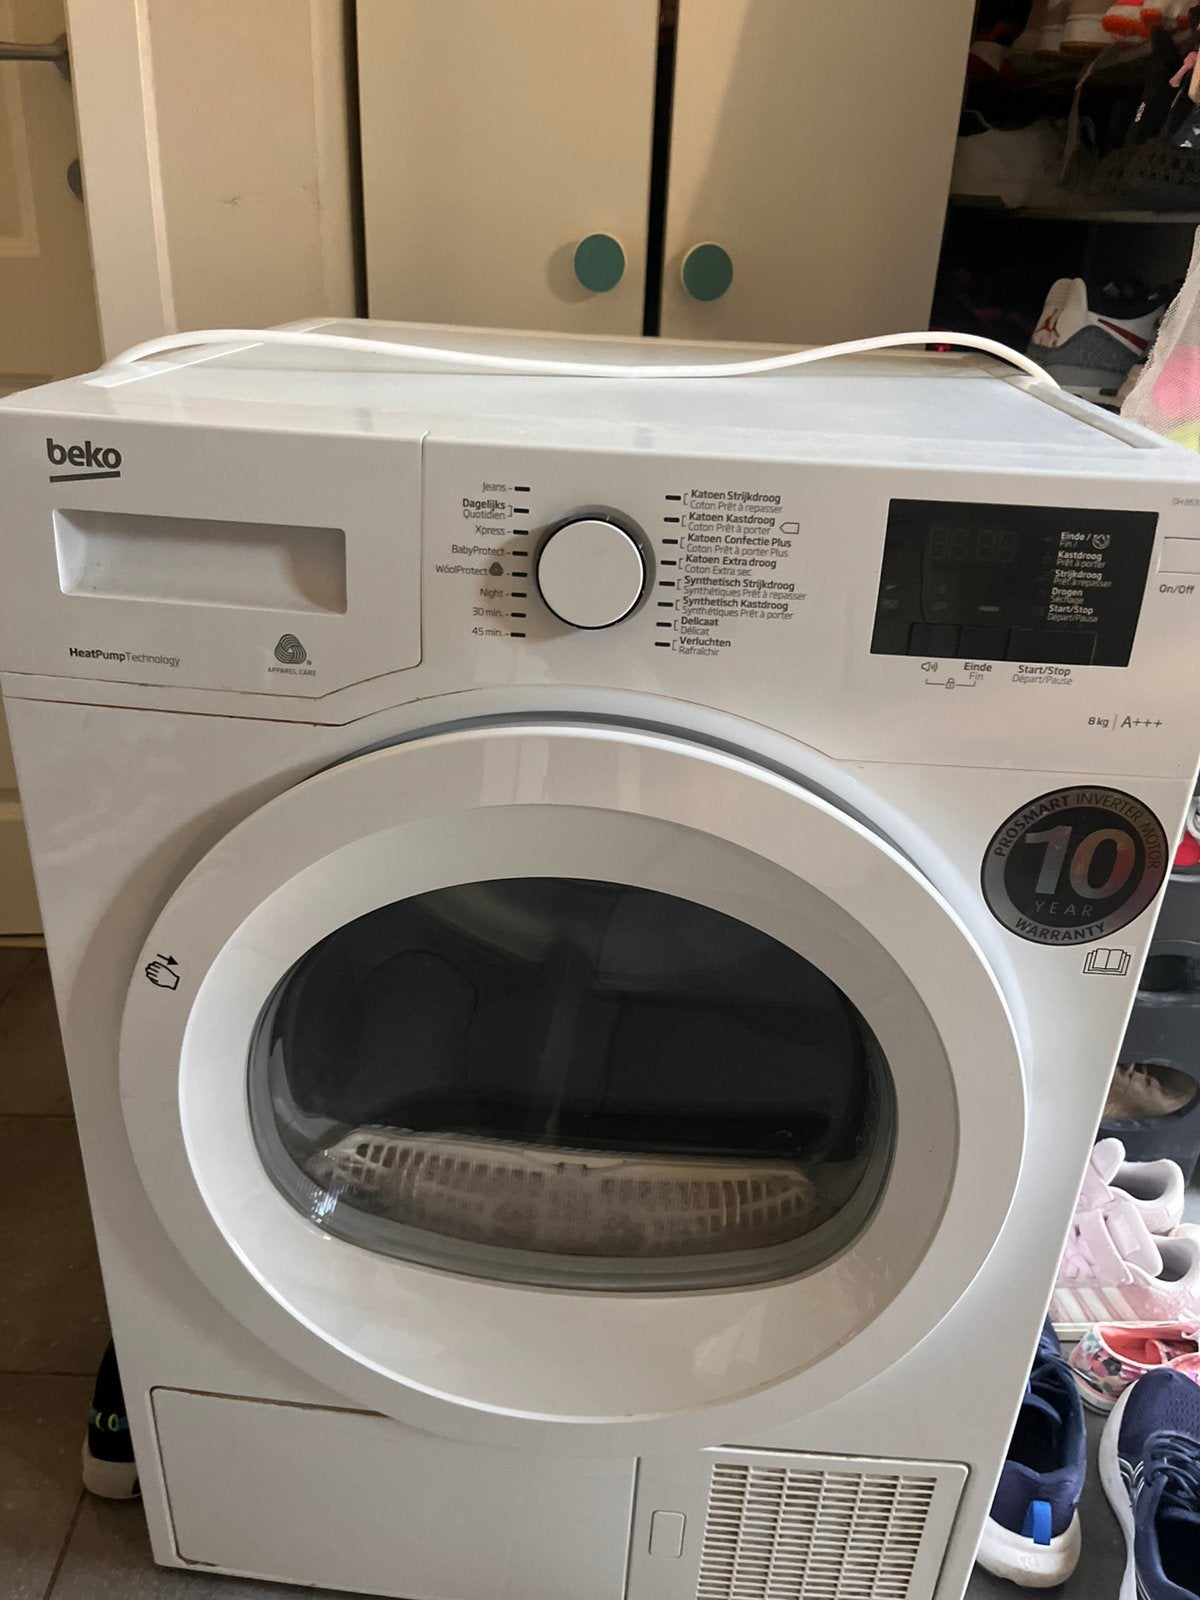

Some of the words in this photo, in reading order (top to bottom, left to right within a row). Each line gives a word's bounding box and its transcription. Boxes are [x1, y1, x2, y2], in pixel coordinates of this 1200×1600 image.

[46, 438, 122, 469] beko
[482, 482, 506, 493] Jeans
[691, 489, 726, 500] Katoen
[727, 491, 781, 505] Strijkdroog
[462, 498, 506, 511] Dagelijks
[690, 500, 716, 510] Coton
[718, 501, 736, 511] Prêt
[737, 502, 743, 512] à
[745, 504, 783, 514] repasser
[463, 508, 506, 519] Quotidien
[689, 512, 723, 522] Katoen
[726, 514, 775, 527] Kastdroog
[475, 525, 506, 535] Xpress
[688, 522, 714, 532] Coton
[716, 523, 734, 533] Prêt
[736, 524, 742, 533] à
[744, 525, 771, 536] porter
[687, 533, 722, 544] Katoen
[724, 534, 769, 546] Confectie
[771, 537, 792, 548] Plus
[1061, 531, 1085, 541] Einde
[452, 544, 505, 556] BabyProtect
[1060, 540, 1072, 548] Fin
[686, 543, 712, 553] Coton
[714, 544, 733, 554] Prêt
[734, 545, 740, 554] à
[741, 547, 769, 557] porter
[770, 548, 789, 558] Plus
[1058, 550, 1102, 561] Kastdroog
[685, 554, 720, 564] Katoen
[722, 555, 747, 566] Extra
[749, 557, 777, 569] droog
[1081, 561, 1106, 569] porter
[435, 564, 488, 576] WoolProtect
[684, 563, 710, 574] Coton
[712, 565, 735, 575] Extra
[737, 568, 752, 576] sec
[1055, 569, 1102, 581] Strijkdroog
[684, 575, 741, 587] Synthetisch
[743, 579, 795, 592] Strijkdroog
[1077, 580, 1112, 588] repasser
[1159, 584, 1195, 594] On/Off
[480, 588, 503, 599] Night
[683, 585, 741, 597] Synthétiques
[743, 588, 761, 599] Prêt
[762, 590, 768, 599] à
[769, 591, 807, 601] repasser
[1052, 587, 1083, 597] Drogen
[683, 596, 738, 608] Synthetisch
[740, 599, 788, 612] Kastdroog
[1049, 604, 1094, 615] Start/Stop
[472, 606, 485, 617] 30
[485, 607, 503, 617] min.
[682, 606, 739, 618] Synthétiques
[740, 608, 758, 618] Prêt
[759, 609, 765, 619] à
[766, 611, 793, 620] porter
[681, 616, 719, 626] Delicaat
[471, 627, 484, 636] 45
[485, 628, 502, 637] min.
[680, 626, 710, 636] Délicat
[679, 636, 731, 647] Verluchten
[679, 645, 719, 656] Rafraîchir
[69, 647, 180, 668] HeatPumpTechnology
[268, 667, 297, 675] APPAREL
[299, 669, 316, 677] CARE
[964, 662, 992, 672] Einde
[1017, 664, 1071, 677] Start/Stop
[969, 671, 984, 681] Fin
[1012, 674, 1073, 685] Départ/Pause
[1120, 716, 1163, 728] A+++
[994, 794, 1070, 857] PROSMART
[1076, 792, 1144, 822] INVERTER
[1140, 822, 1162, 869] MOTOR
[1025, 825, 1136, 899] 10
[1035, 900, 1093, 917] YEAR
[1015, 917, 1105, 941] WARRANTY
